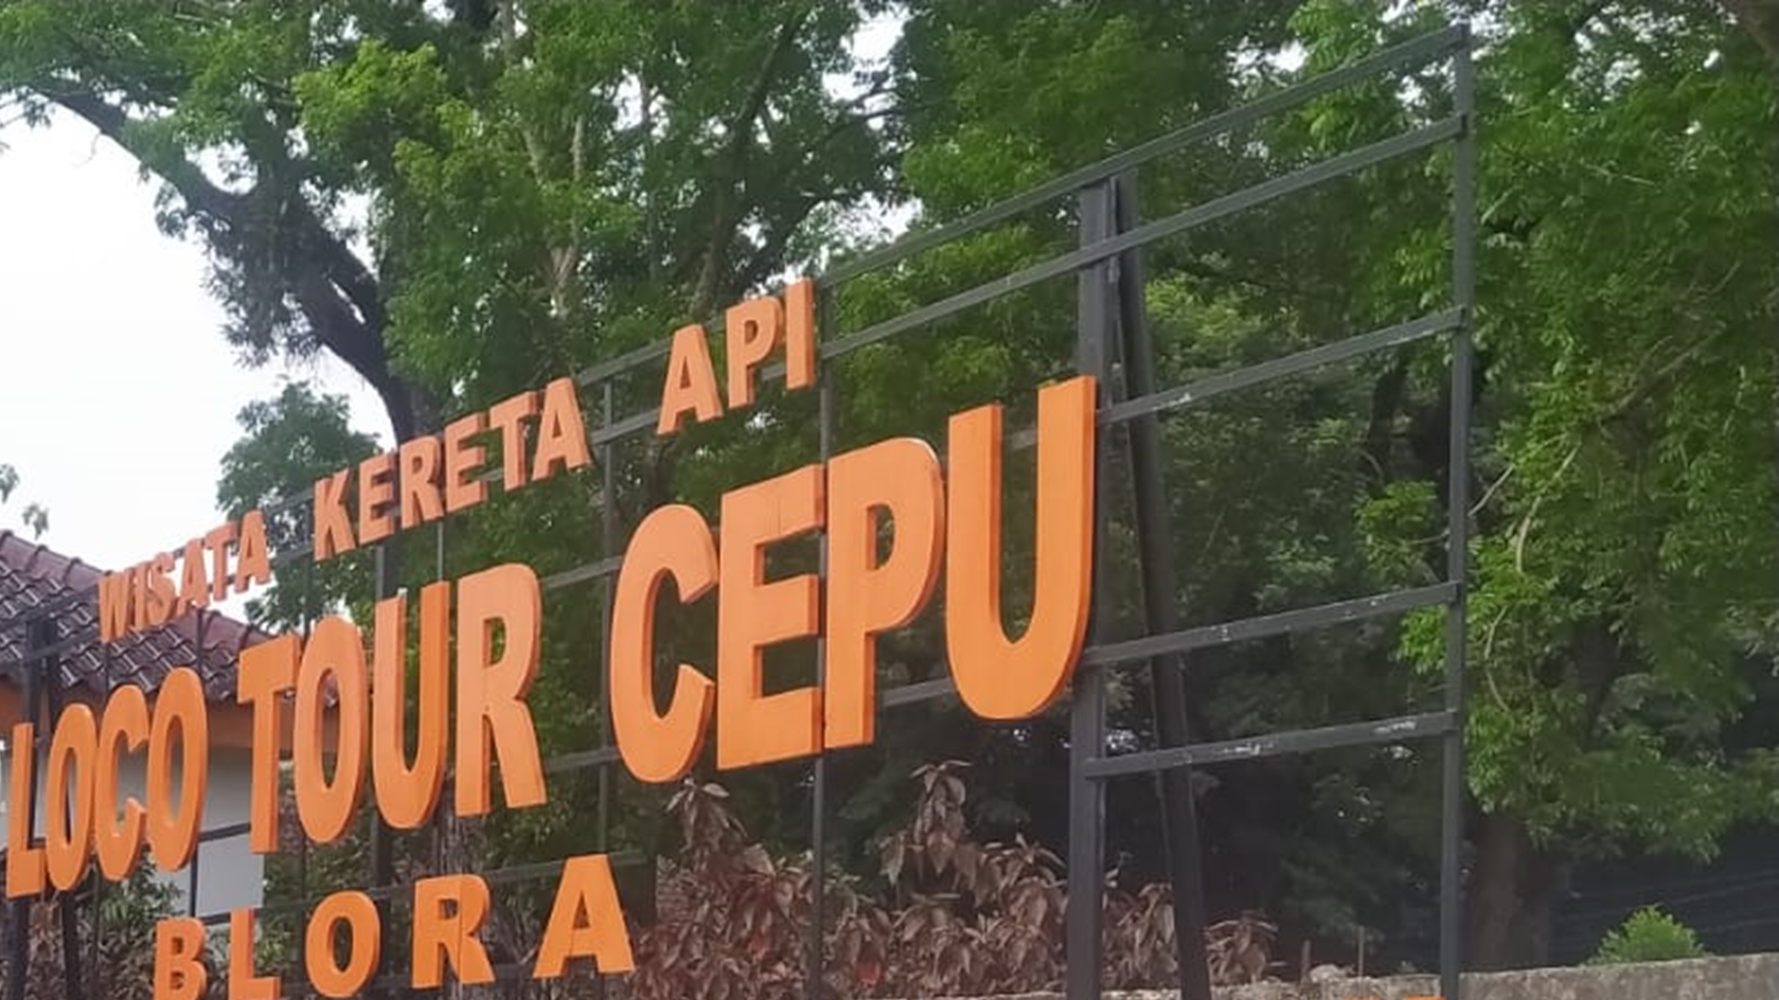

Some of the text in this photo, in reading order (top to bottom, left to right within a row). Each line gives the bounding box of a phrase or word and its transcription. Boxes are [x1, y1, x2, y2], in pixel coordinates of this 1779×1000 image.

[5, 374, 1097, 898] LOCO TOUR CEPU
[100, 279, 817, 642] WISATA KERETA API
